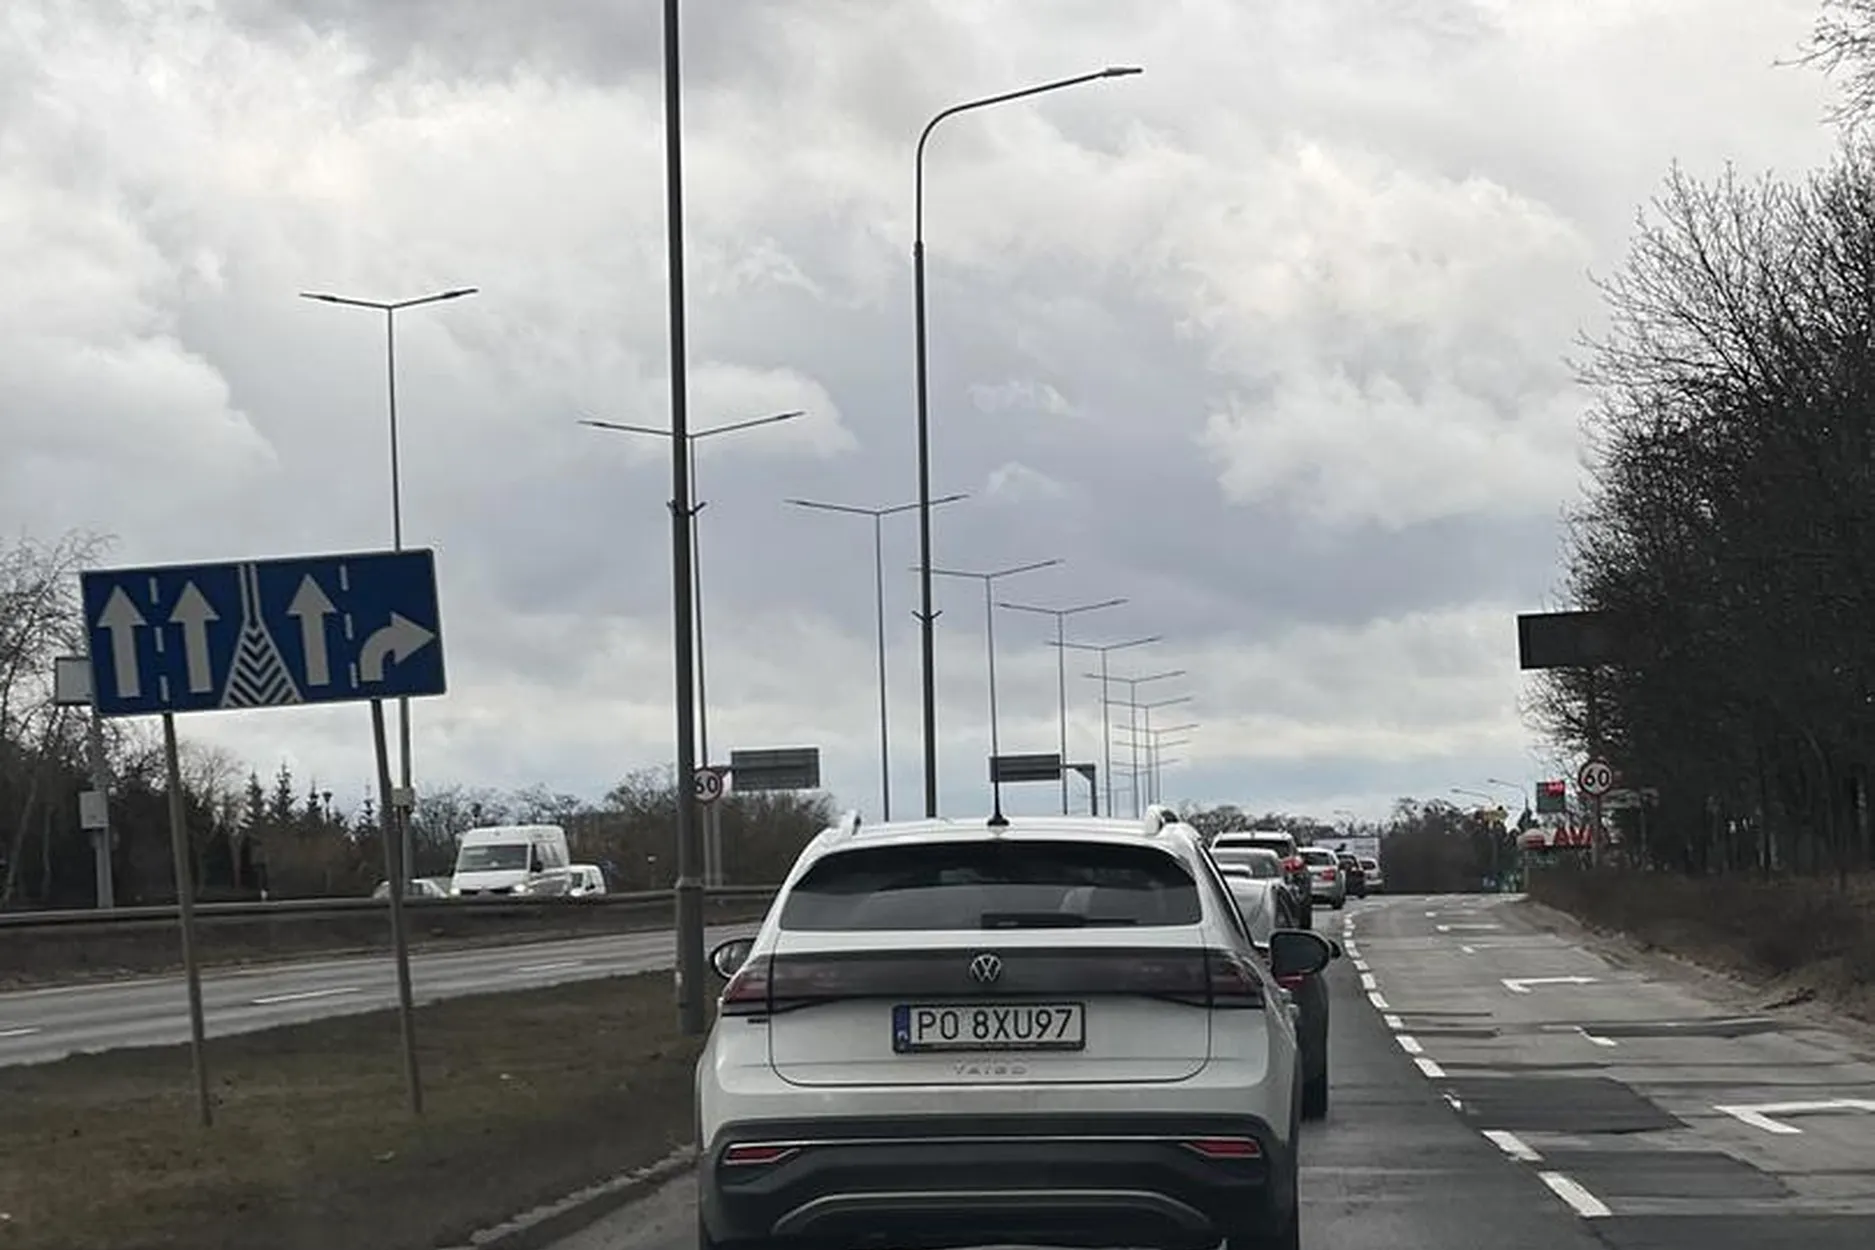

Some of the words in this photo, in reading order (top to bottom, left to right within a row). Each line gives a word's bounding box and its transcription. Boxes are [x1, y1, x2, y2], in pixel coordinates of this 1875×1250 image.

[1584, 769, 1610, 787] 60
[917, 1010, 960, 1041] PO
[972, 1008, 1073, 1040] 8XU97
